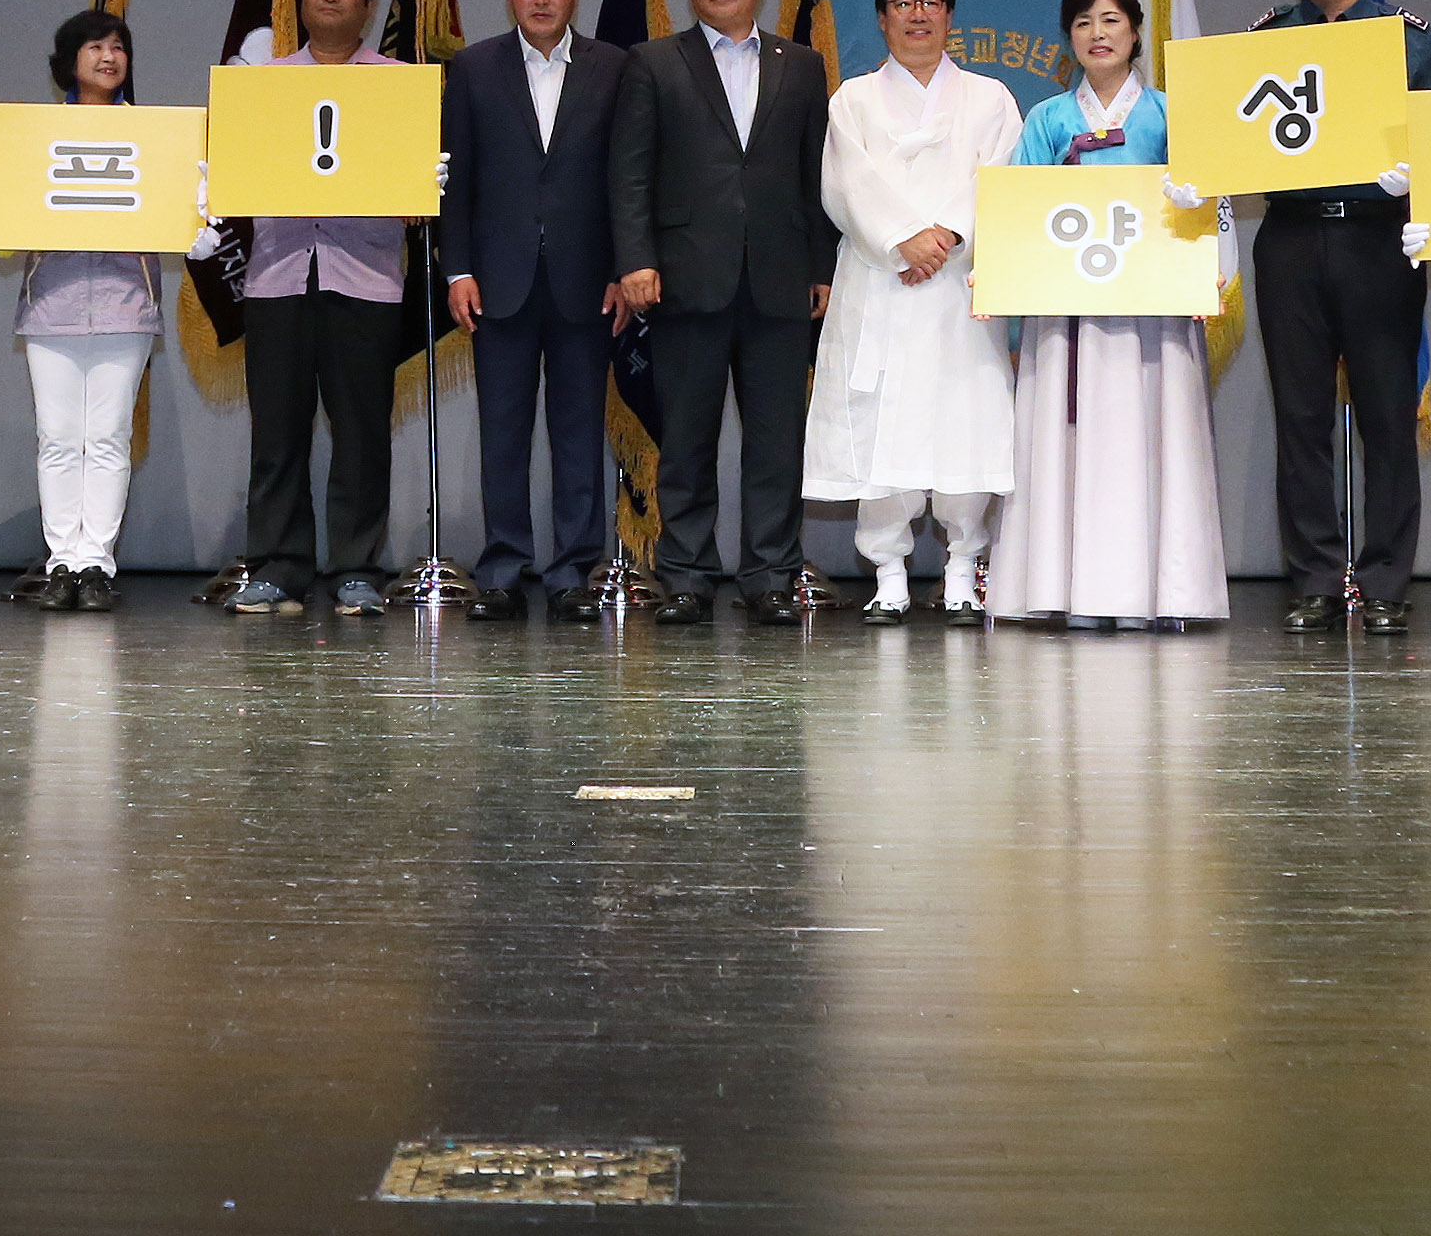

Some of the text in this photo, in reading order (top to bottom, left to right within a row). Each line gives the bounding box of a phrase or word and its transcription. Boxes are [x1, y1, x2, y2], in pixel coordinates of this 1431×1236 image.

[318, 105, 335, 170] !
[1242, 69, 1319, 149] 성
[50, 143, 137, 209] 프
[1050, 204, 1141, 278] 양
